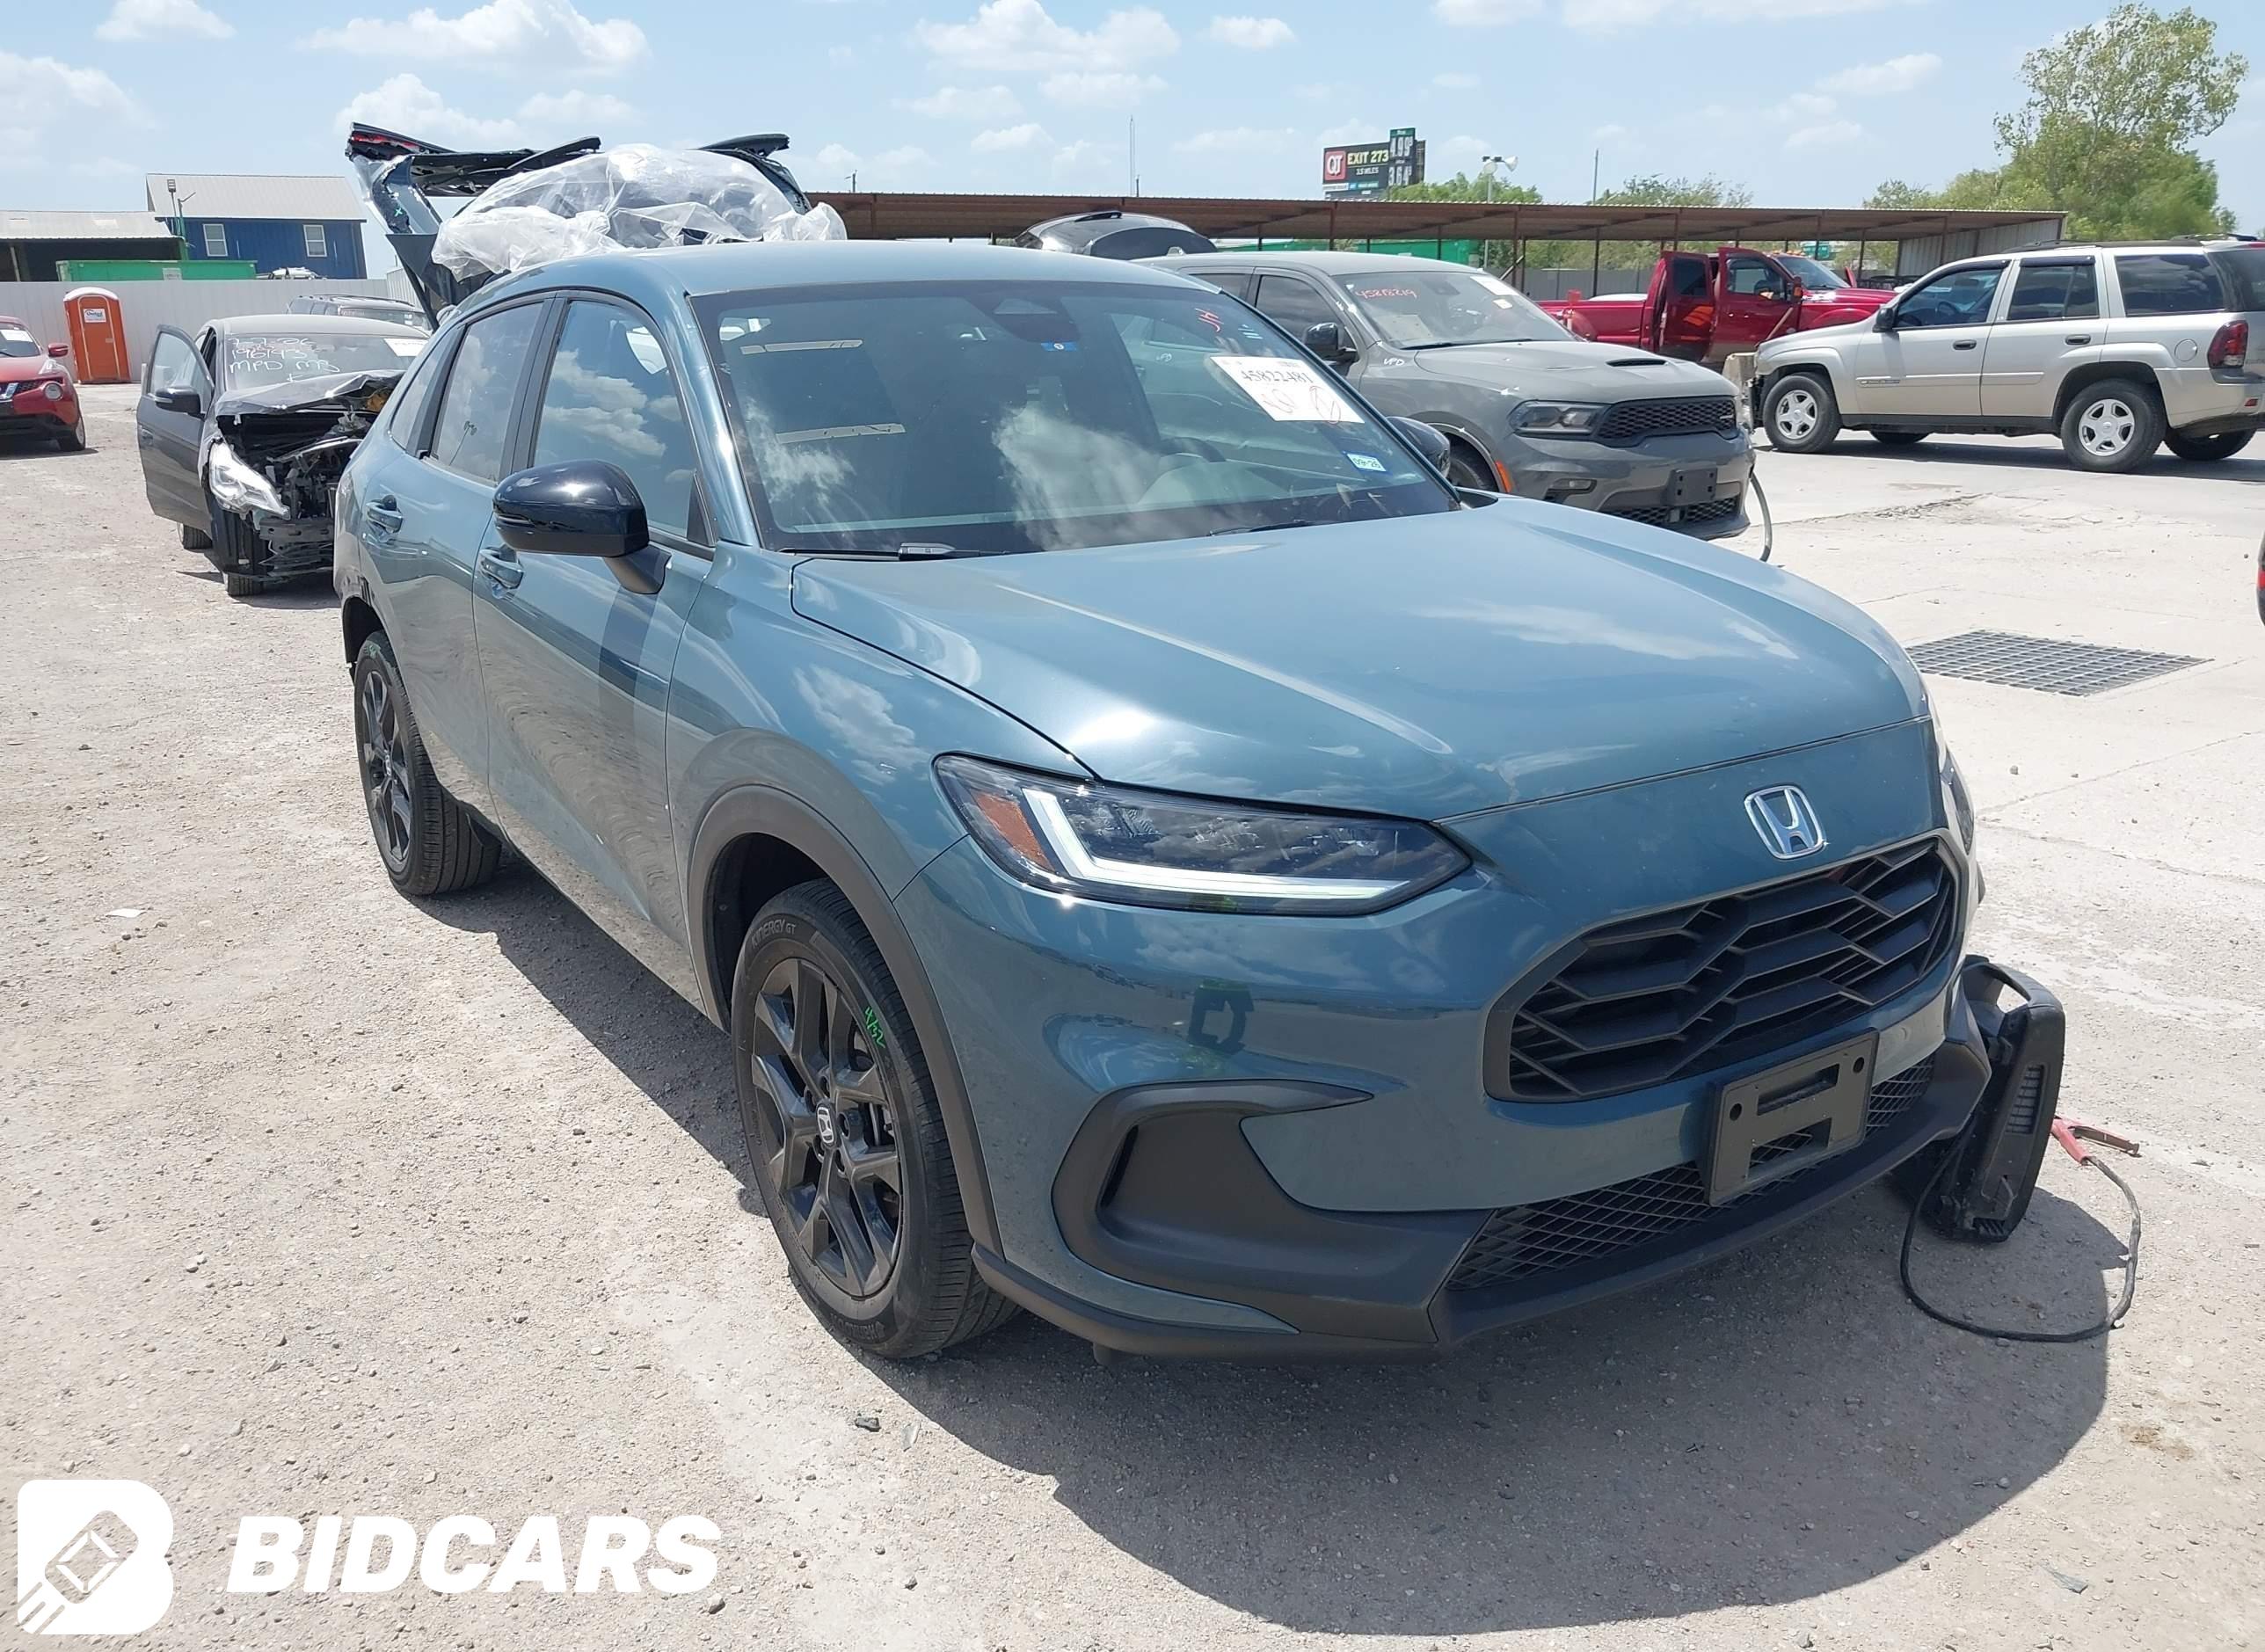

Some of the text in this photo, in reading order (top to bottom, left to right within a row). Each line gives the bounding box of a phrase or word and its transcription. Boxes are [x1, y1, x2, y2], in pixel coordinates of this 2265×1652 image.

[1347, 149, 1389, 165] EXIT 273
[1327, 155, 1343, 175] QT
[229, 360, 283, 373] MPD
[1241, 370, 1314, 384] 45822481
[785, 923, 797, 935] GT
